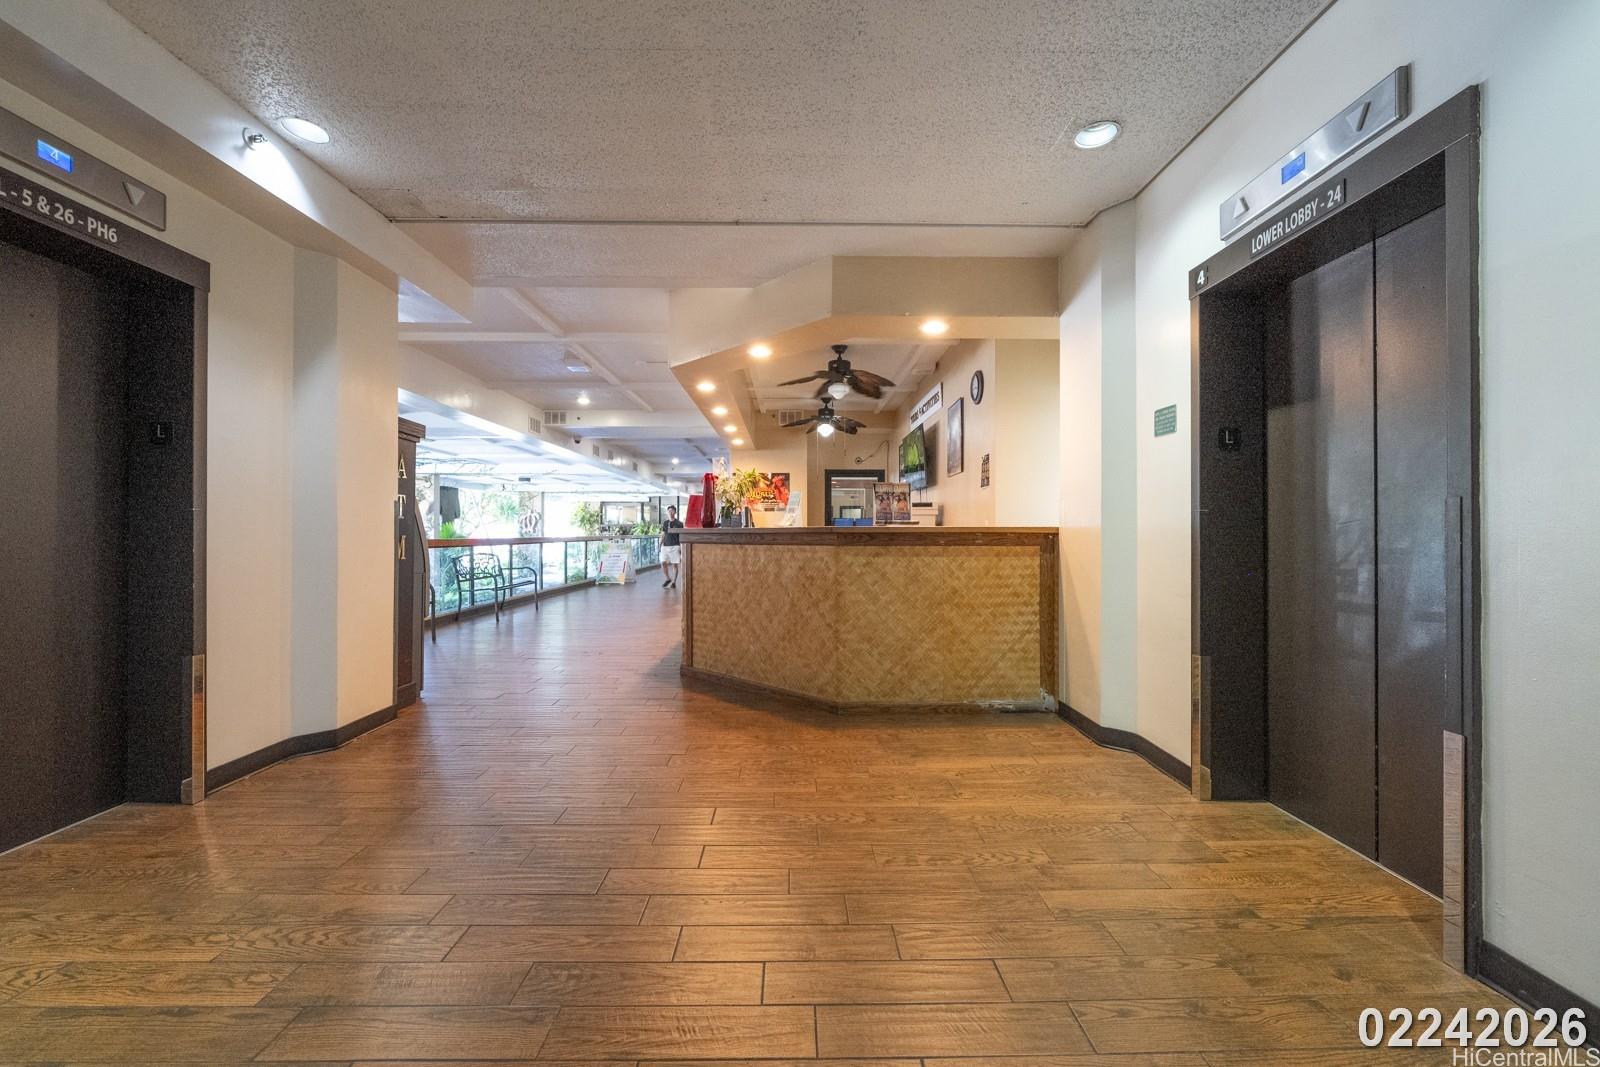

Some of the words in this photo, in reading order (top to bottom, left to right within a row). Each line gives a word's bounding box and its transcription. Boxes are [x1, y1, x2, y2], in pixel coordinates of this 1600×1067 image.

[22, 188, 33, 207] 5
[37, 195, 50, 216] &
[53, 202, 75, 226] 26
[87, 216, 118, 244] PH6
[1251, 221, 1284, 254] LOWER
[1285, 198, 1319, 234] LOBBY
[1327, 184, 1342, 209] 24
[1196, 269, 1205, 285] 4
[1225, 430, 1234, 444] L
